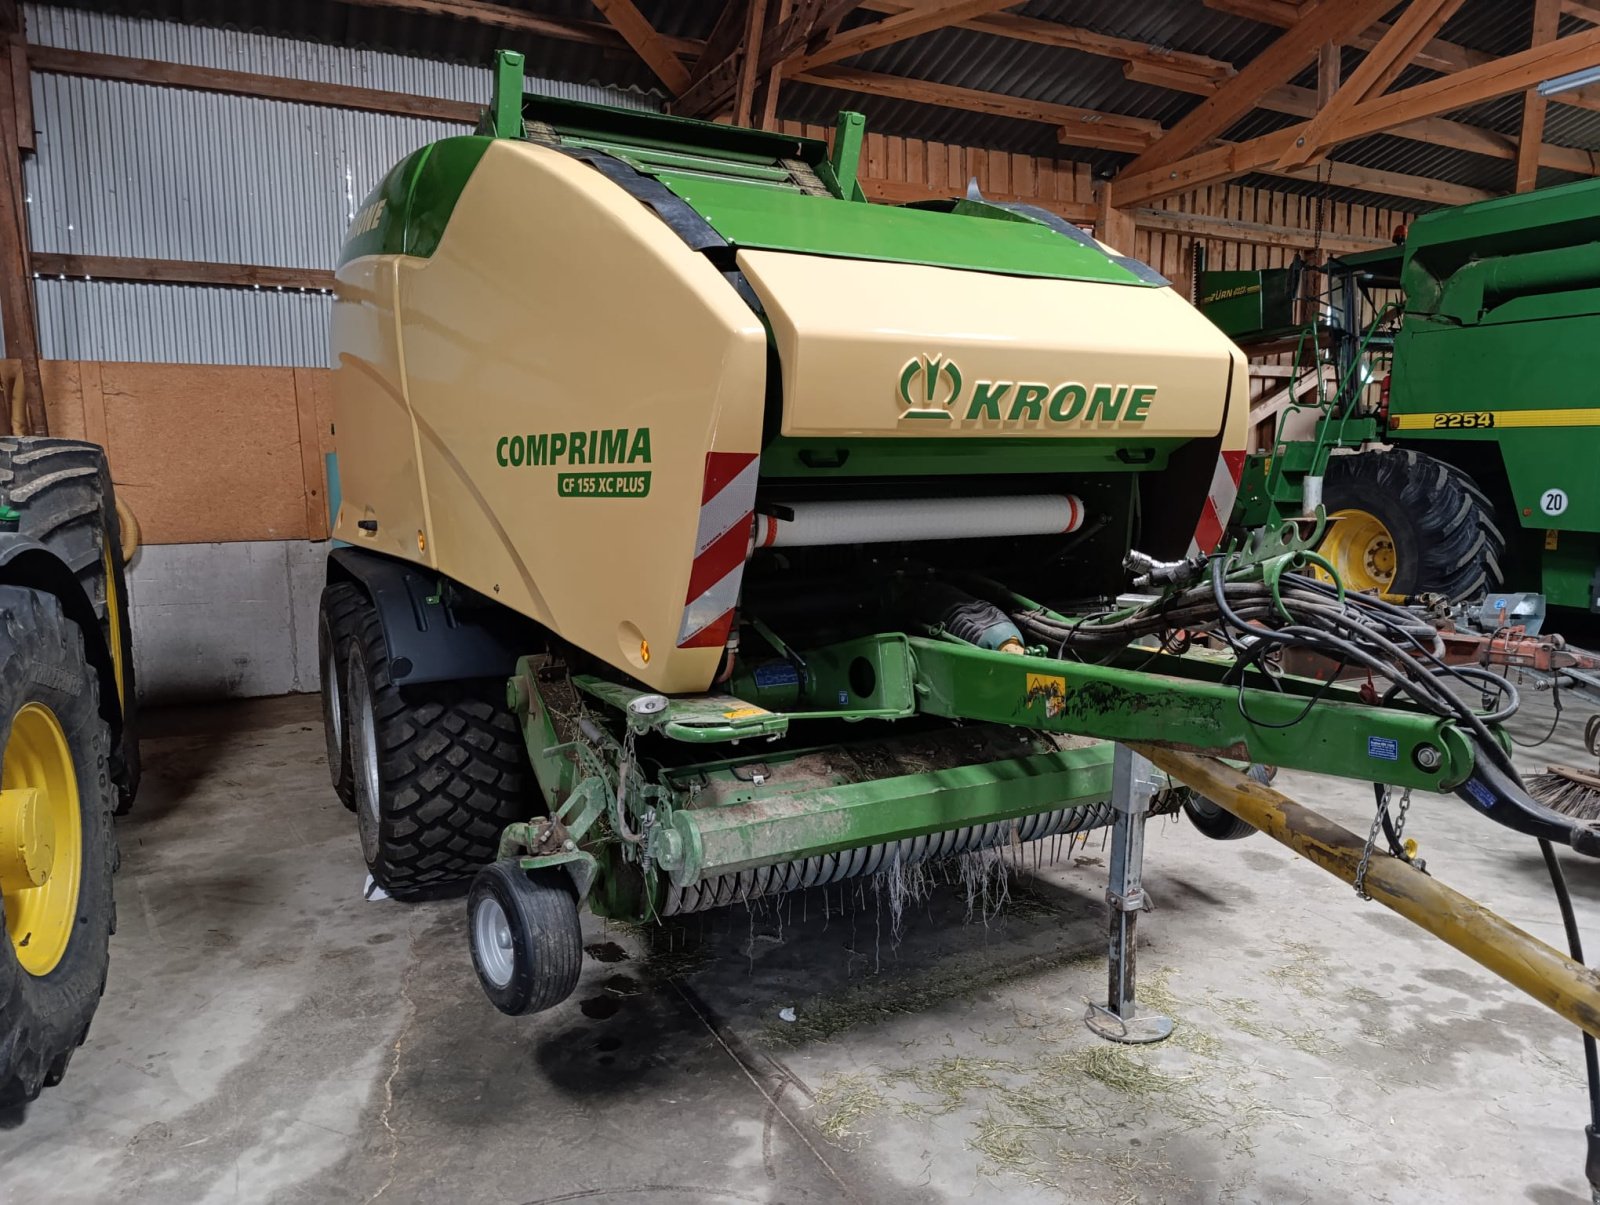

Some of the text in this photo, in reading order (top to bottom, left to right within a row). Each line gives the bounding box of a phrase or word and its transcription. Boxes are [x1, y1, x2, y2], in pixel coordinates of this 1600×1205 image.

[963, 380, 1158, 423] KRONE
[1434, 413, 1494, 429] 2254
[496, 427, 652, 467] COMPRIMA
[562, 476, 645, 493] CF 155 XC PLUS
[1545, 493, 1562, 511] 20
